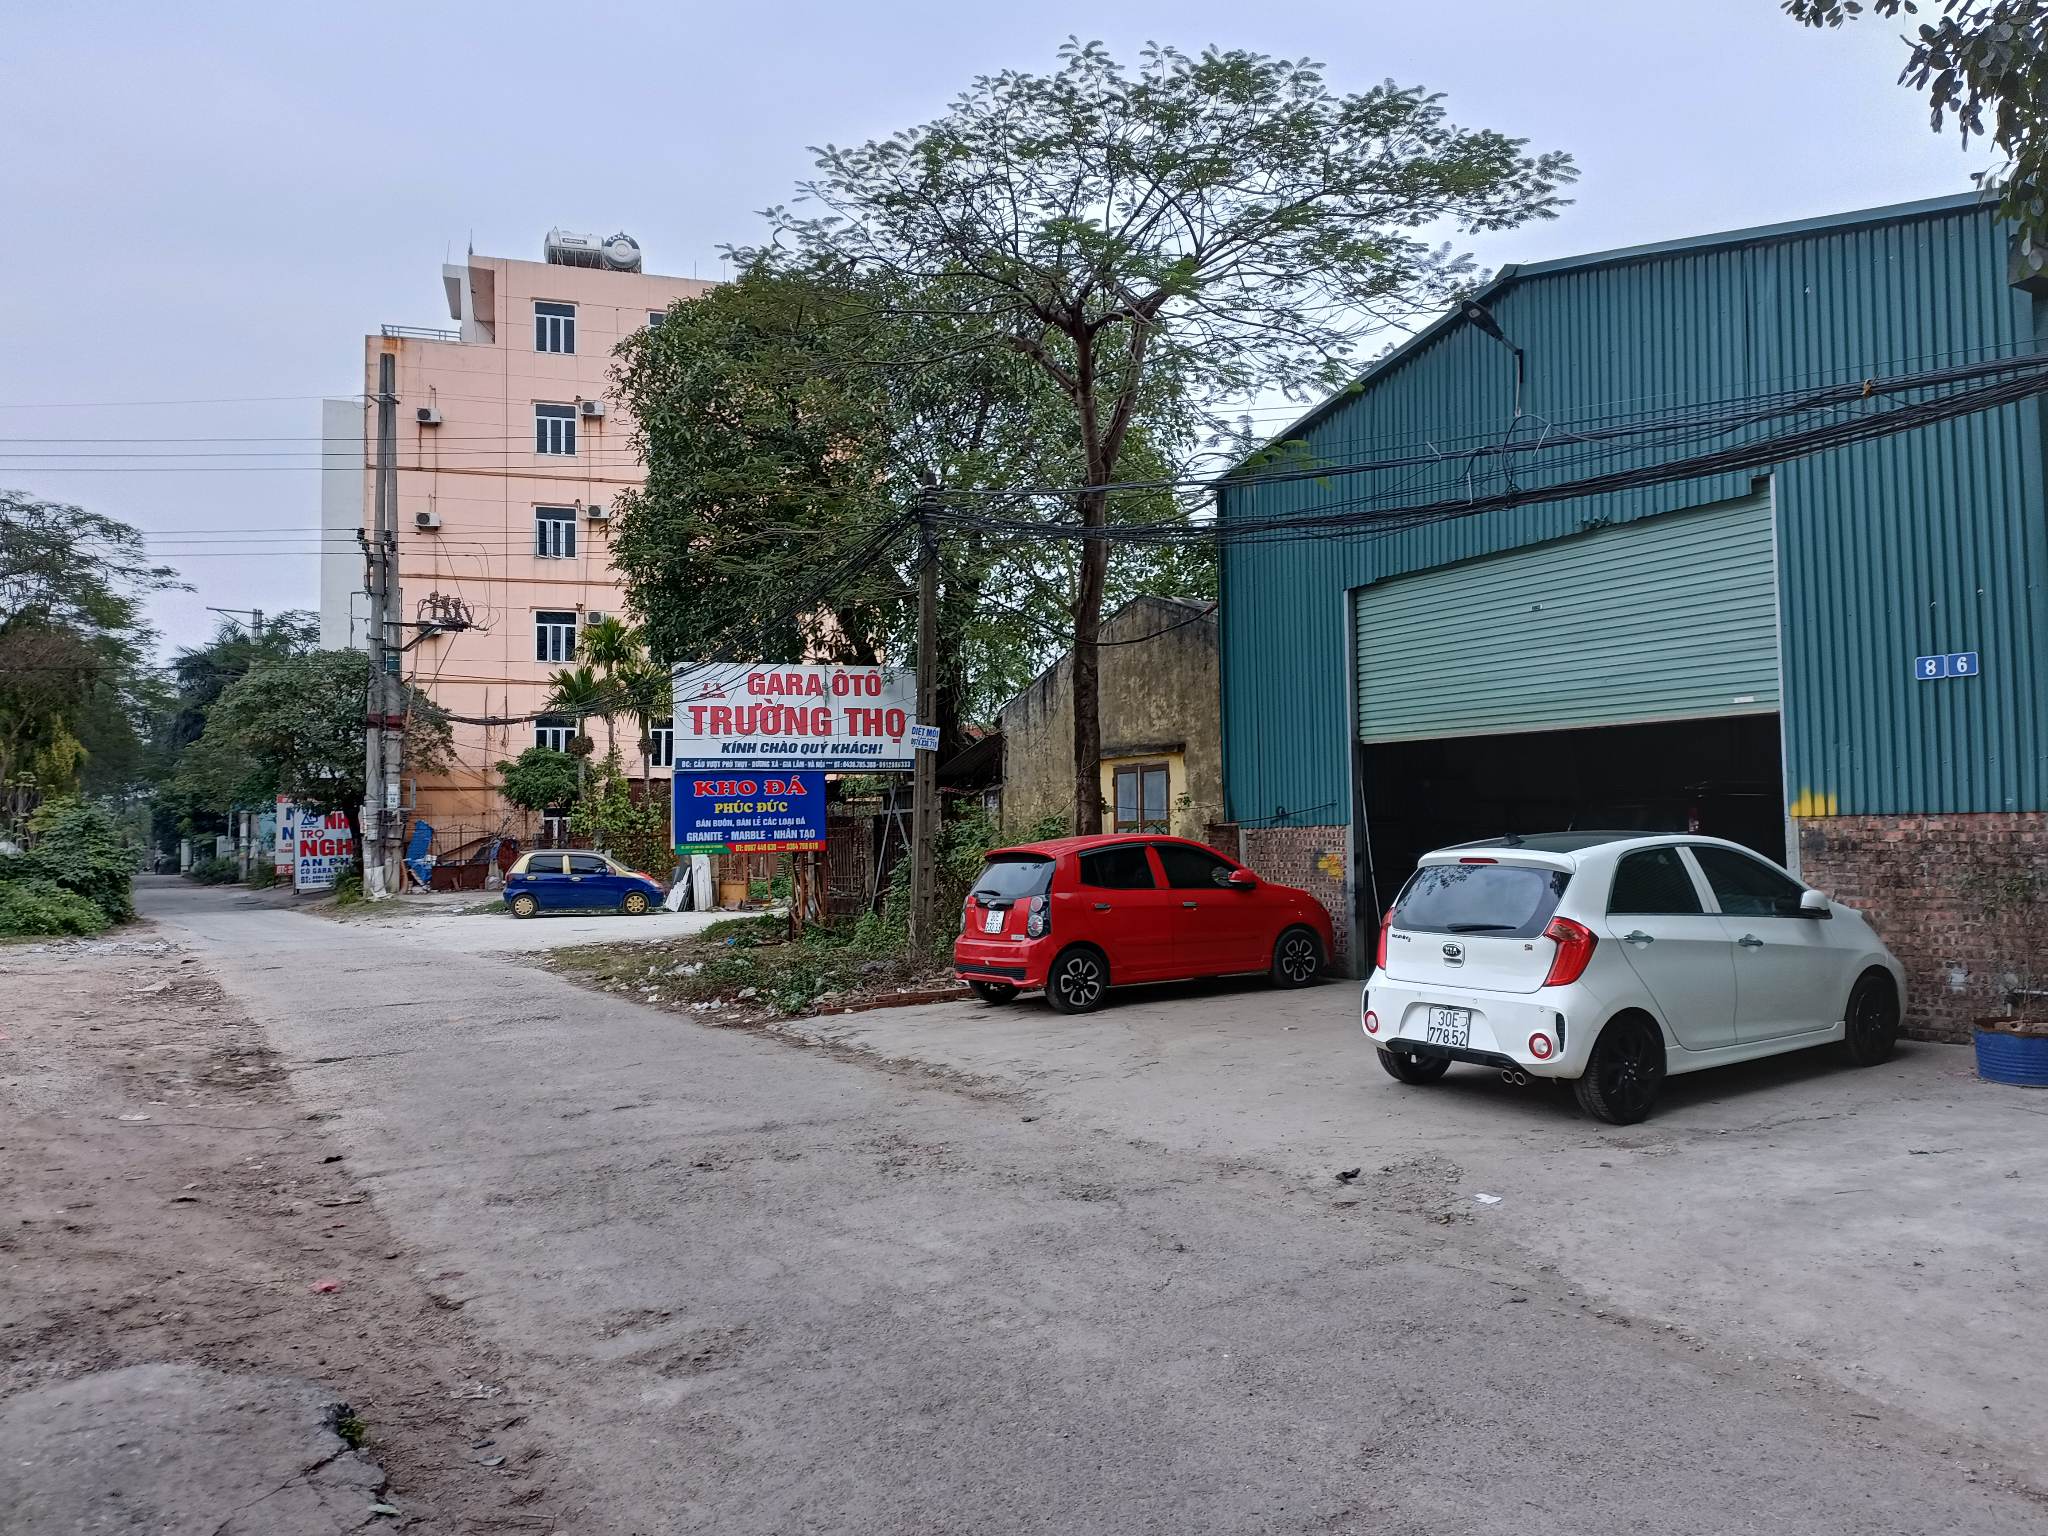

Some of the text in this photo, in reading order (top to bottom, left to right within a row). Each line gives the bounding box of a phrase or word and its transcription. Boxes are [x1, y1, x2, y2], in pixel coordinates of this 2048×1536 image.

[747, 668, 881, 697] GARA ÔTÔ
[688, 698, 906, 743] TRƯỜNG THỌ
[721, 741, 884, 755] KÍNH CHÀO QUÝ KHÁCH!
[783, 760, 792, 768] GIA
[693, 775, 807, 798] KHO ĐÁ
[714, 799, 788, 814] PHÚC ĐỨC
[695, 818, 711, 828] BÁN
[736, 817, 751, 827] BÁN
[763, 816, 778, 827] CÁC
[779, 817, 794, 827] LOẠI
[301, 829, 324, 840] TRỌ
[687, 827, 816, 843] GRANITE MARBLE NHÂN TẠO
[300, 839, 352, 857] NGH
[301, 857, 349, 867] AN PH
[1438, 1010, 1460, 1028] 30E
[1429, 1026, 1466, 1047] 778.52
